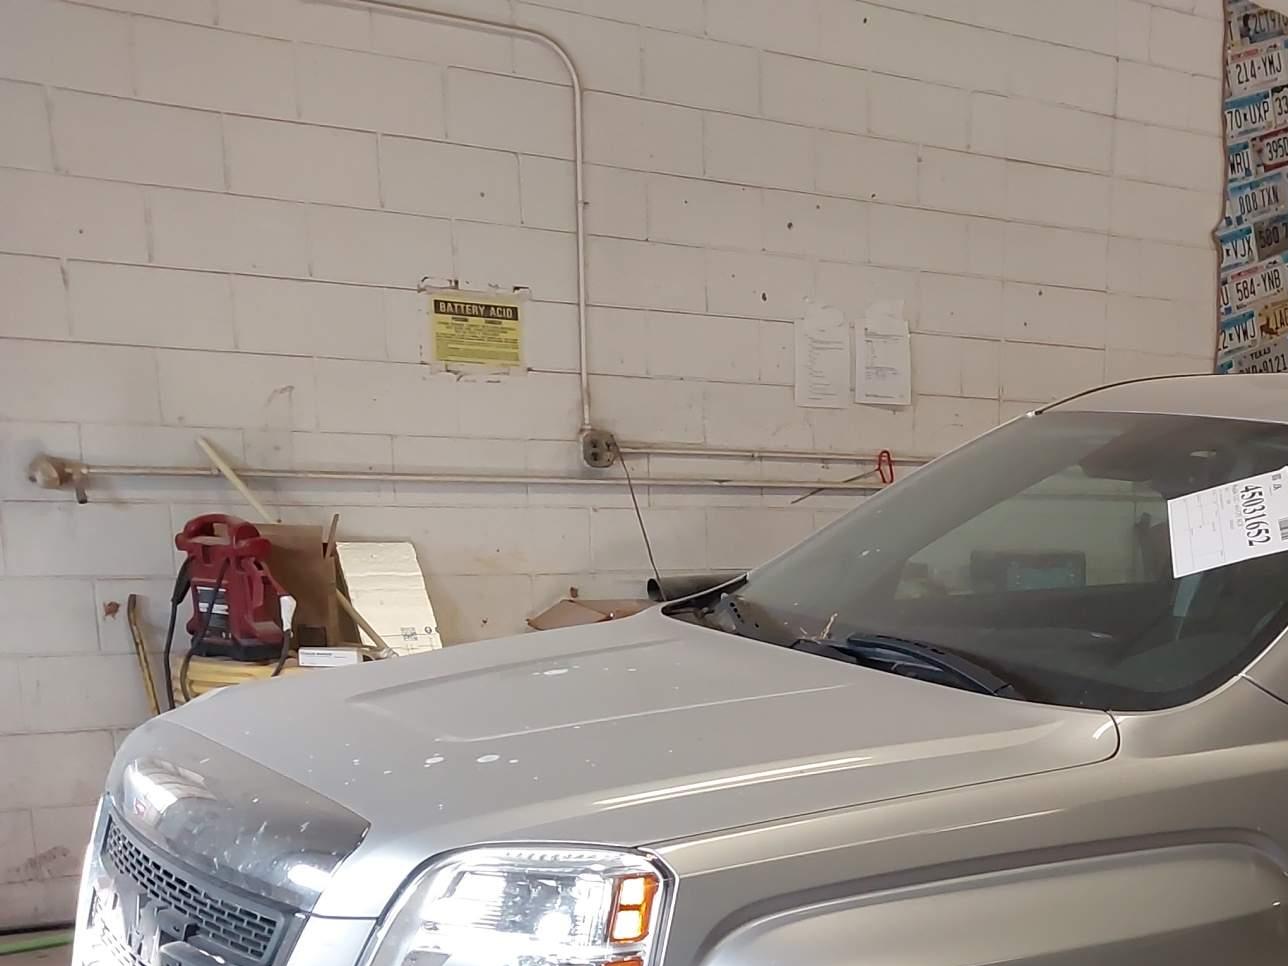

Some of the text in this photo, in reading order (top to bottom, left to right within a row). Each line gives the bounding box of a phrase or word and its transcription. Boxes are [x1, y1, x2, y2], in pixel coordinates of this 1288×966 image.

[439, 301, 513, 319] BATTERY ACID
[1240, 484, 1272, 547] 45031652
